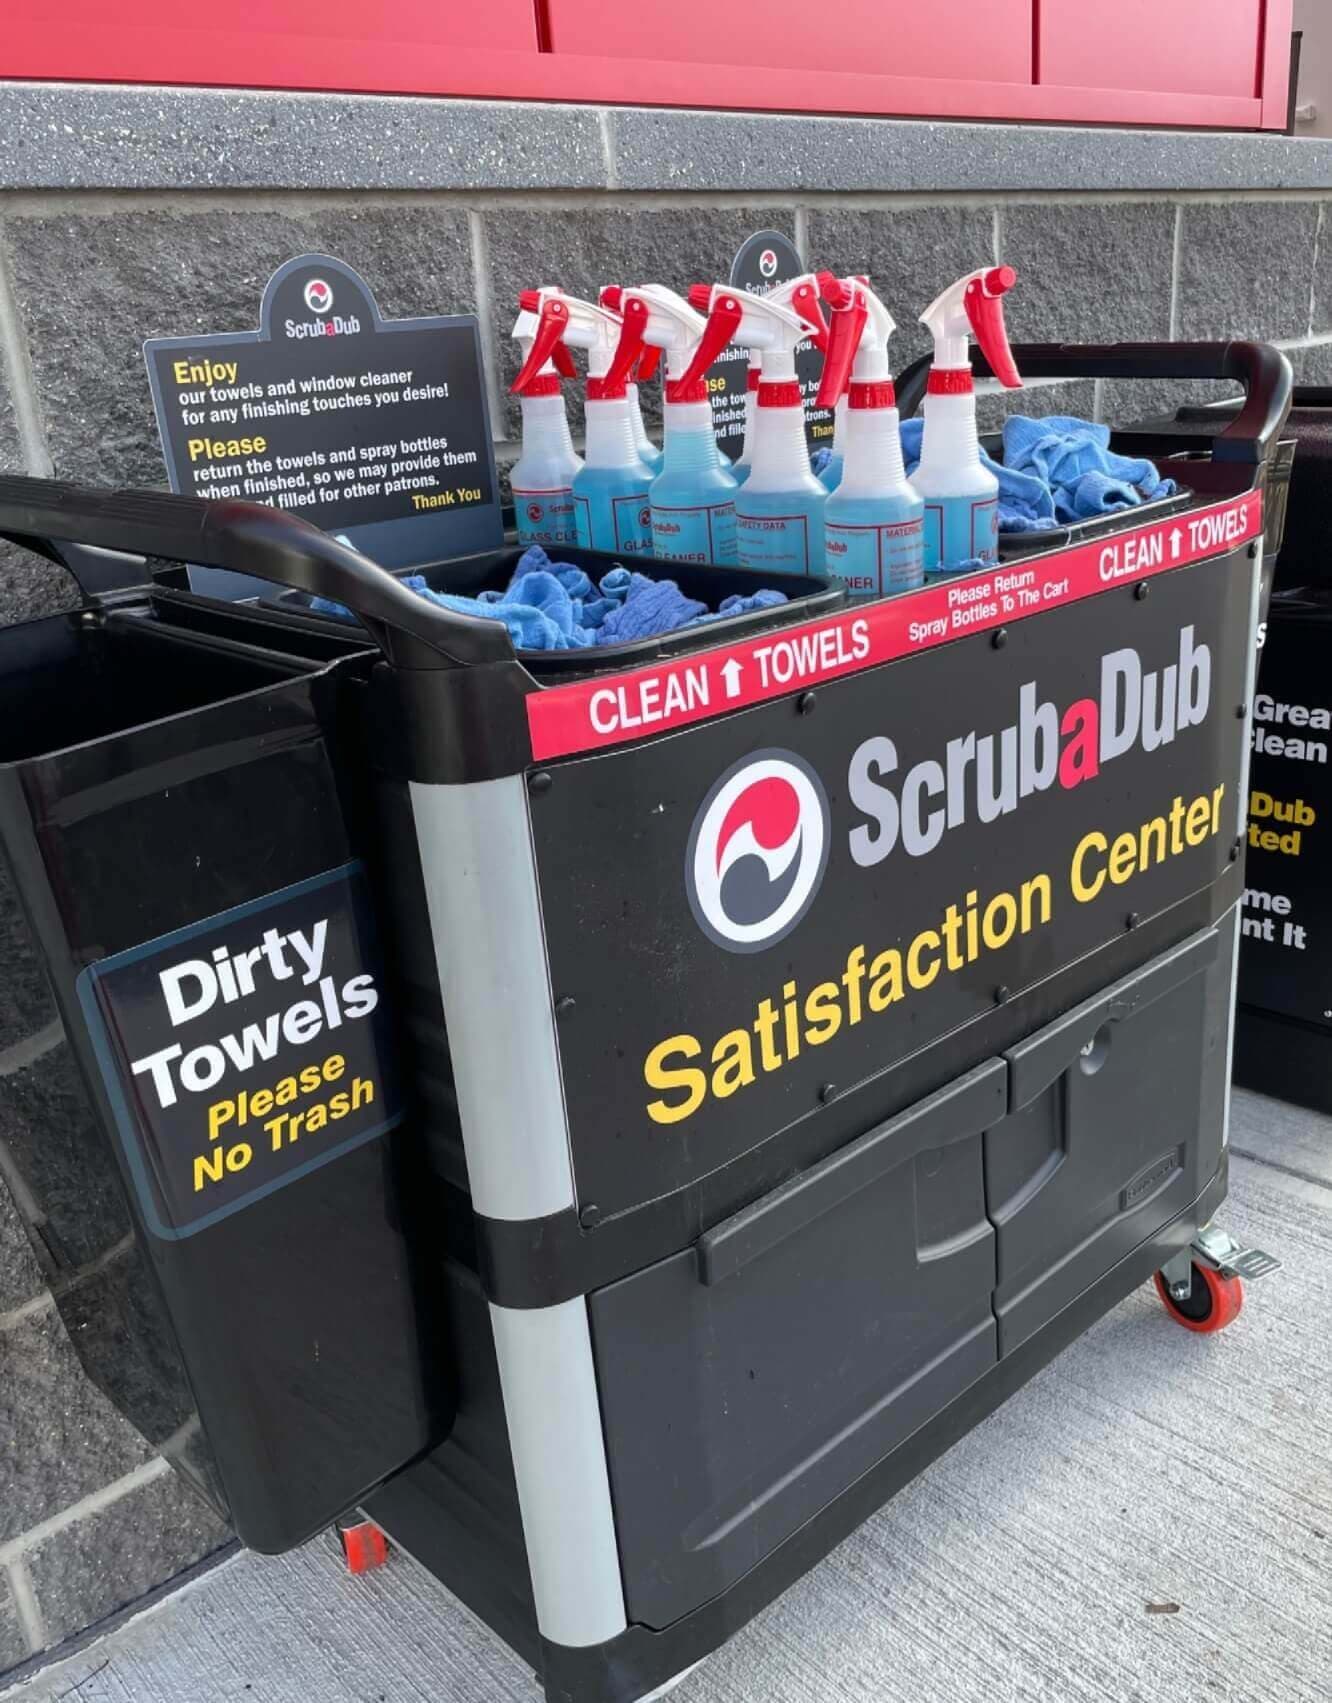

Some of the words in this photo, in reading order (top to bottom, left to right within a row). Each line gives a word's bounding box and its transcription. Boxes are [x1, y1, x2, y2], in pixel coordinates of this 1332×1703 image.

[284, 314, 361, 339] ScrubaDub
[173, 359, 238, 387] Enjoy
[178, 390, 205, 405] our
[210, 383, 263, 402] towels
[267, 379, 297, 397] and
[299, 375, 356, 393] window
[360, 371, 413, 387] cleaner
[181, 409, 205, 426] for
[210, 407, 238, 424] any
[242, 397, 310, 419] finishing
[312, 393, 372, 411] touches
[374, 391, 399, 407] you
[402, 383, 449, 401] desire!
[712, 394, 728, 407] the
[805, 409, 832, 421] trons.
[188, 436, 267, 461] Please
[714, 425, 726, 438] nd
[811, 424, 836, 438] Than
[193, 464, 243, 482] return
[246, 459, 273, 475] the
[276, 451, 326, 471] towels
[329, 446, 356, 464] and
[360, 443, 398, 461] spray
[400, 436, 448, 454] bottles
[196, 482, 241, 499] when
[244, 475, 311, 496] finished,
[313, 471, 331, 485] so
[334, 469, 355, 482] we
[359, 463, 388, 478] may
[391, 455, 441, 476] provide
[443, 451, 477, 466] them
[277, 489, 316, 509] filled
[319, 488, 340, 504] for
[343, 482, 381, 499] other
[384, 474, 440, 496] patrons.
[412, 491, 455, 510] Thank
[457, 488, 481, 502] You
[763, 521, 786, 530] DATA
[1099, 532, 1163, 582] CLEAN
[1188, 504, 1248, 553] TOWELS
[623, 538, 653, 552] GLAS
[948, 580, 991, 608] Please
[994, 571, 1035, 593] Return
[908, 616, 948, 642] Spray
[952, 603, 998, 630] Bottles
[1001, 595, 1016, 613] To
[1017, 588, 1041, 608] The
[1043, 579, 1069, 600] Cart
[589, 664, 710, 735] CLEAN
[753, 619, 871, 688] TOWELS
[1252, 694, 1332, 731] Grea
[847, 624, 1212, 868] ScrubaDub
[644, 873, 1052, 1125] Satisfaction
[1070, 783, 1225, 903] Center
[1283, 922, 1307, 950] It
[159, 918, 328, 1027] Dirty
[131, 973, 379, 1109] Towels
[208, 1053, 346, 1141] Please
[193, 1142, 252, 1192] No
[263, 1076, 374, 1152] Trash
